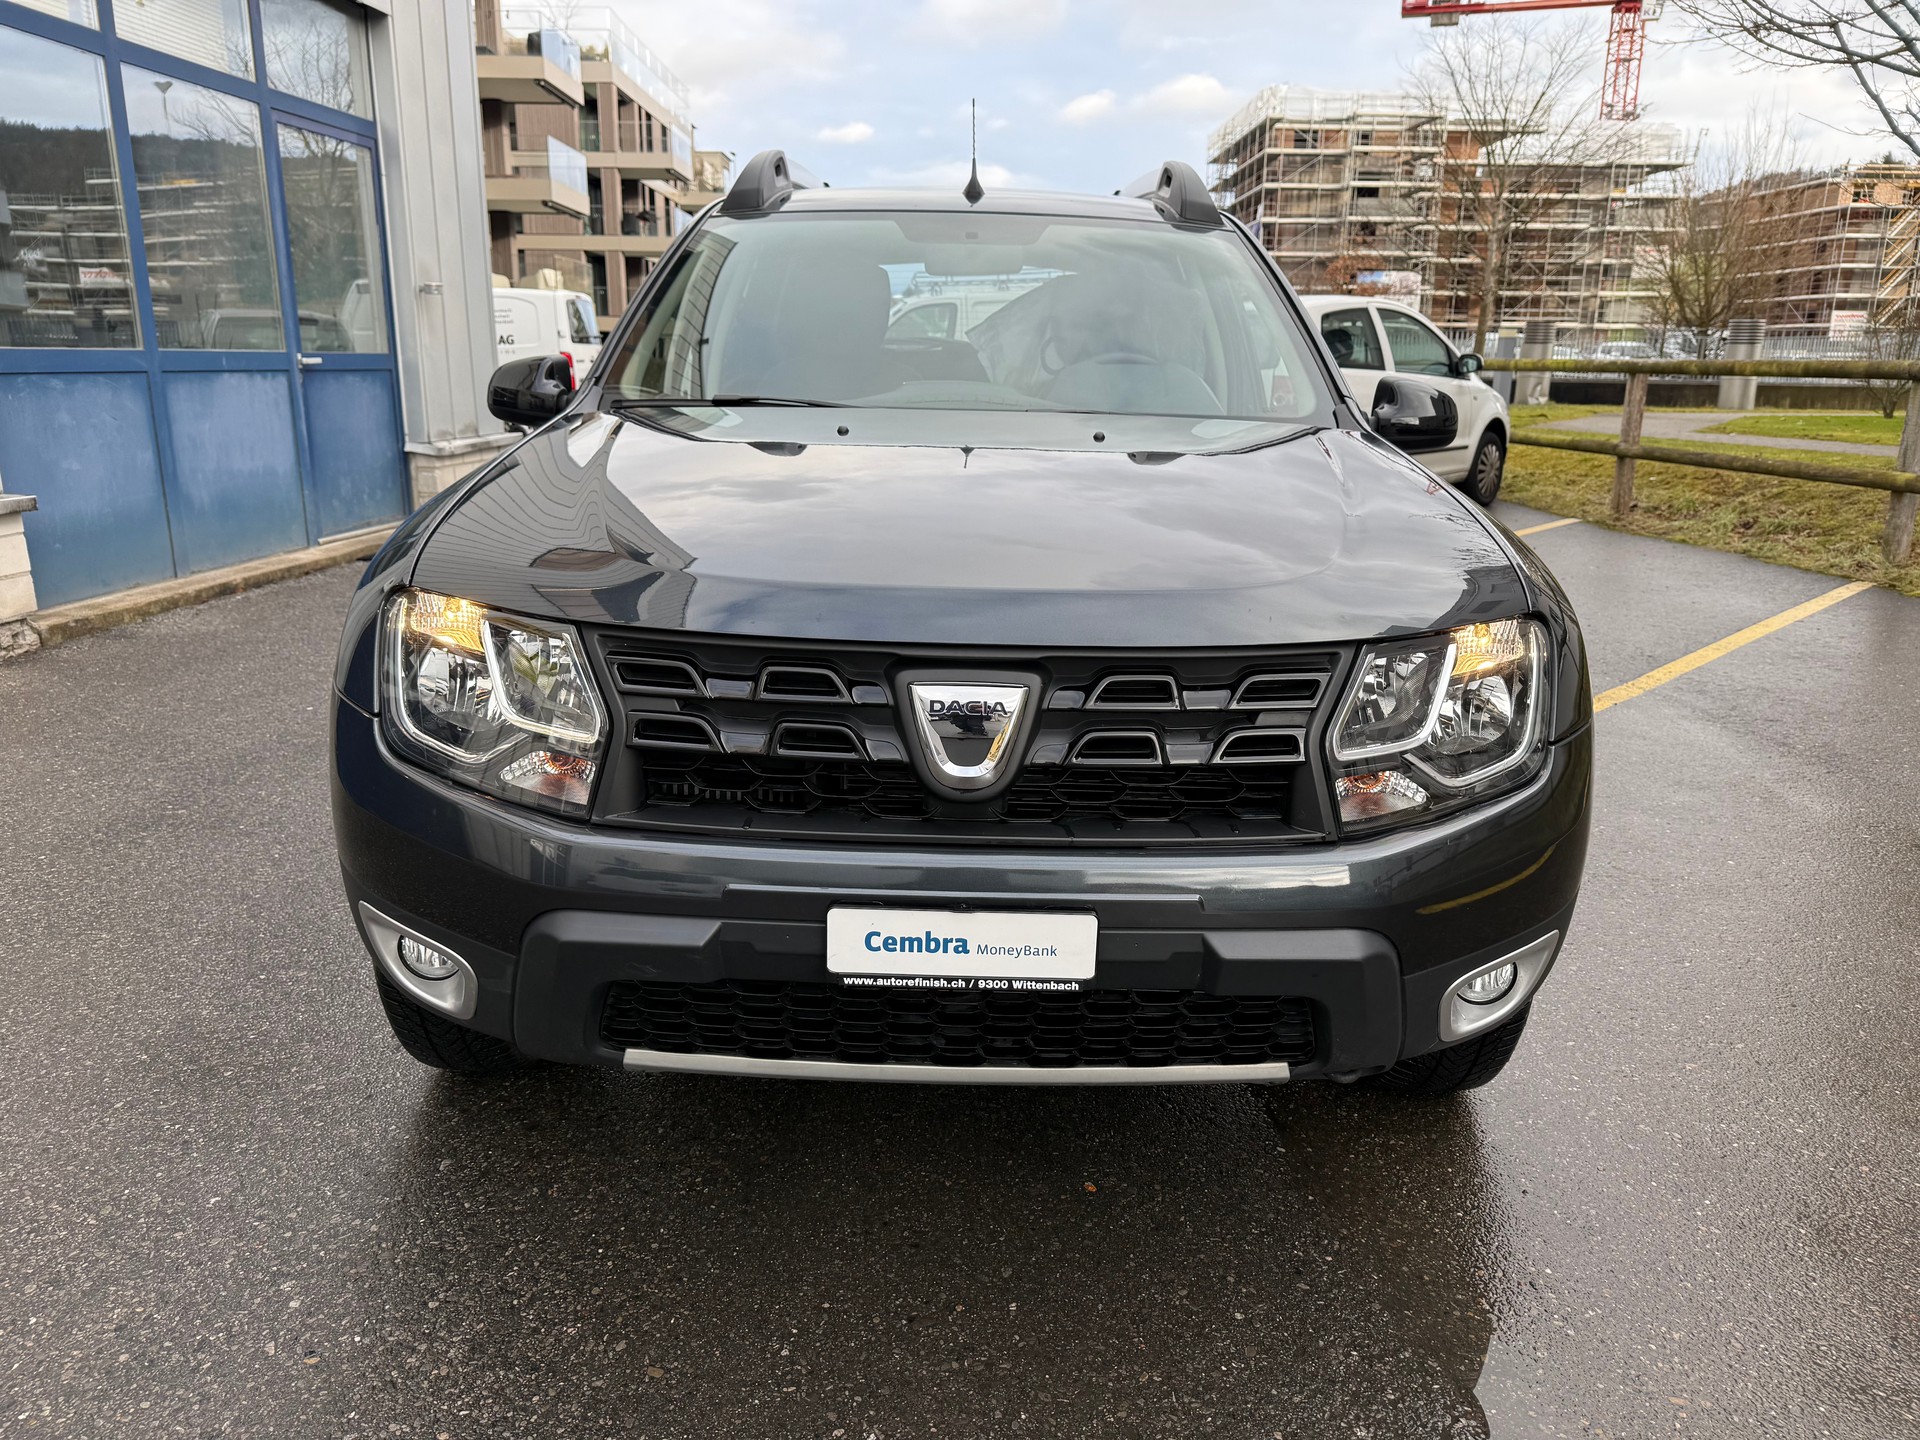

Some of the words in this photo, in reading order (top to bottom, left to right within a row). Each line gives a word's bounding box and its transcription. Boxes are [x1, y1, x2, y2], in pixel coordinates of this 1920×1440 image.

[498, 334, 514, 345] AG
[929, 700, 1008, 716] DACIA
[864, 931, 970, 955] Cembra
[976, 943, 1058, 959] MoneyBank
[843, 976, 966, 989] www.autorefinish.ch
[977, 979, 1009, 990] 9300
[1012, 980, 1080, 991] Wittenbach
